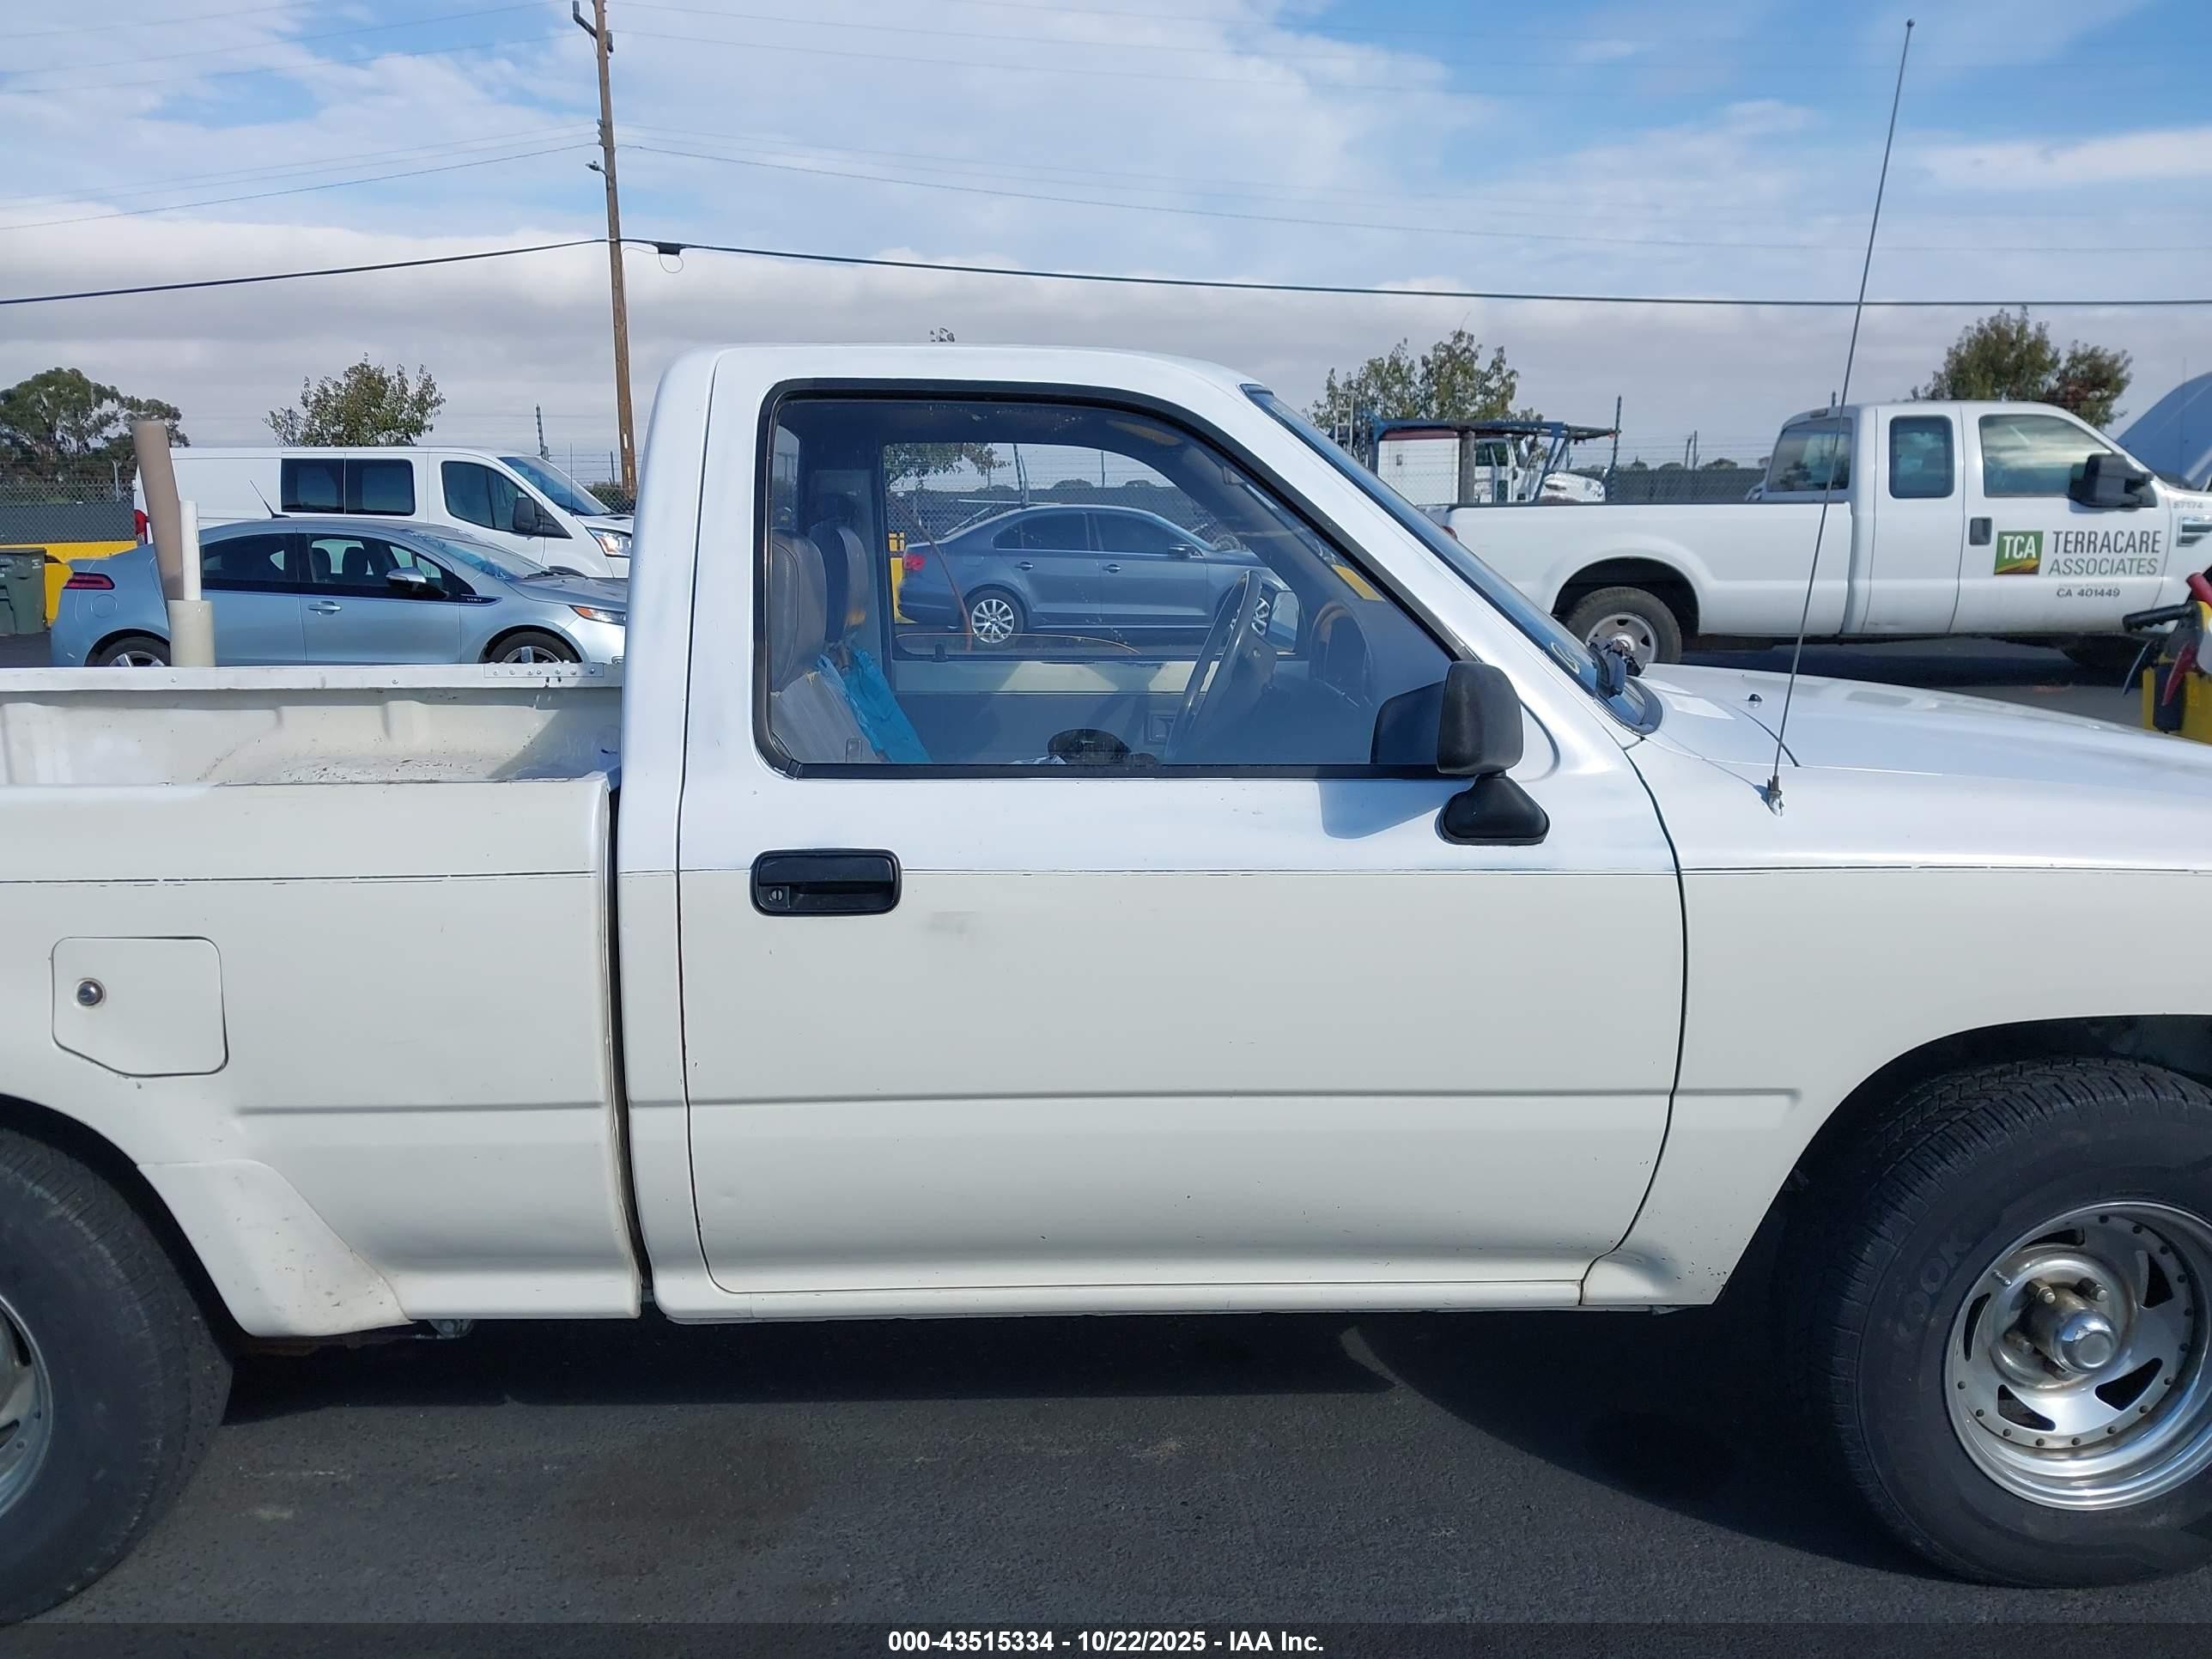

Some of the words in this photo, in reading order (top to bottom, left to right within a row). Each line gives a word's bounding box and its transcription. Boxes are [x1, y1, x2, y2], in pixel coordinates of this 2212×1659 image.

[2002, 535, 2037, 559] TCA
[2052, 530, 2162, 554] TERRACARE
[2048, 557, 2159, 576] ASSOCIATES
[2056, 587, 2073, 598] CA
[2076, 587, 2121, 599] 401449
